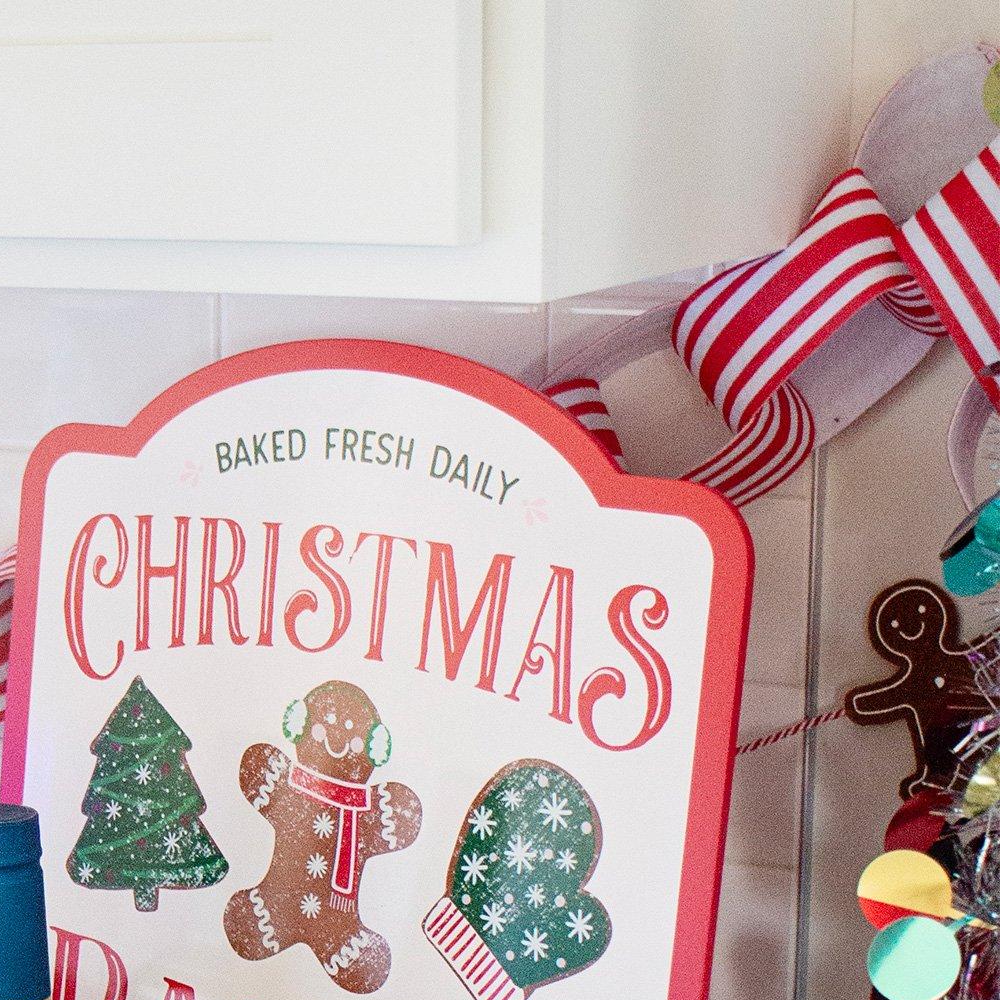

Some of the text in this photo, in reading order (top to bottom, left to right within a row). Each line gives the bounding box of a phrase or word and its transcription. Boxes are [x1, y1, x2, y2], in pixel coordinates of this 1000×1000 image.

[215, 428, 521, 506] BAKED FRESH DAILY
[63, 512, 673, 753] CHRISTMAS
